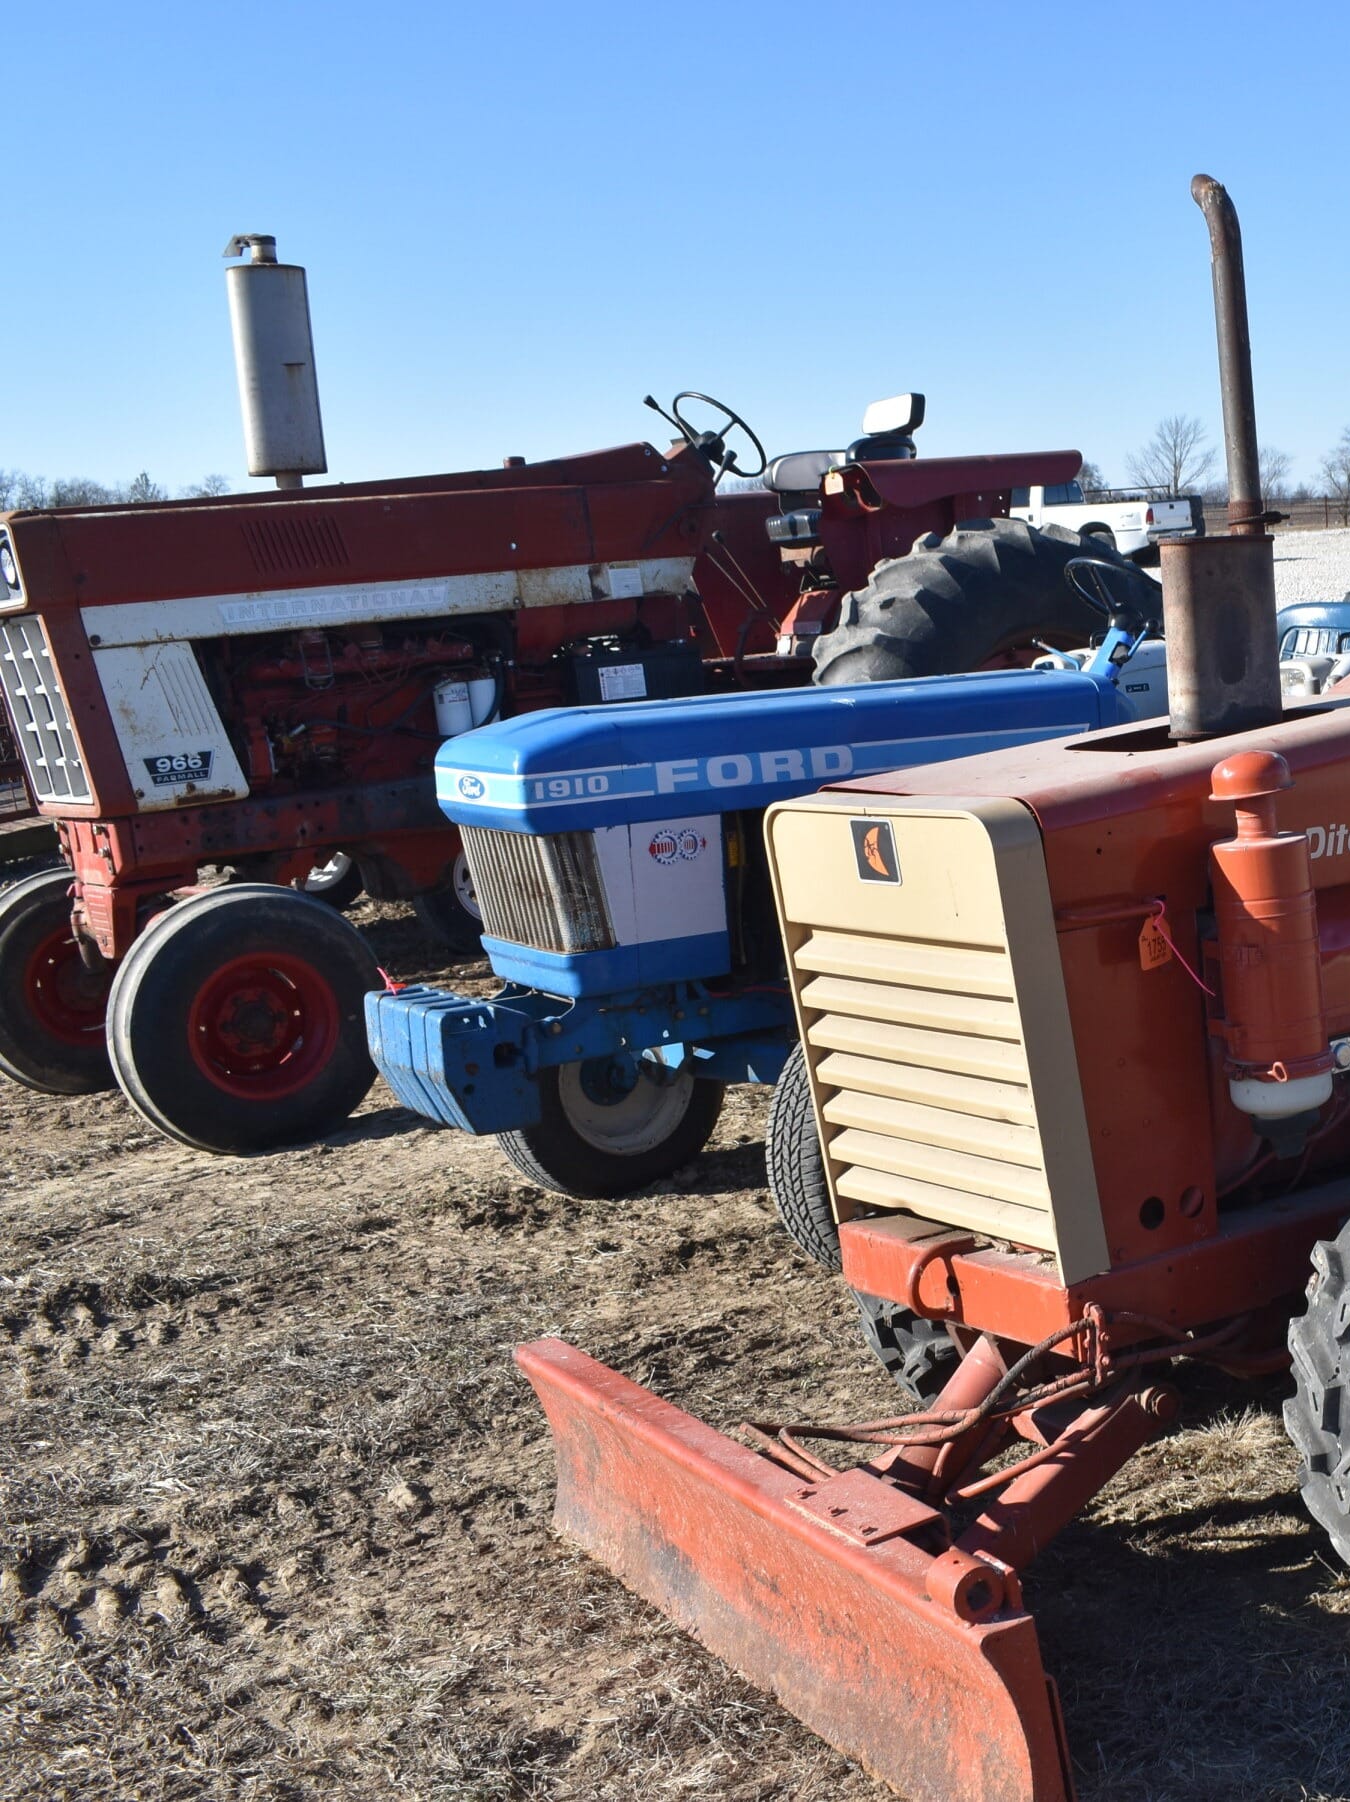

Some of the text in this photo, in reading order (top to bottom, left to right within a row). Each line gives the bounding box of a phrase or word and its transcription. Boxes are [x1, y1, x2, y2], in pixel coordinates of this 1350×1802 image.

[226, 589, 441, 620] INTERNATIONAL
[156, 752, 203, 773] 966
[655, 744, 854, 794] FORD
[156, 771, 207, 783] FARMALL
[534, 775, 609, 800] 1910
